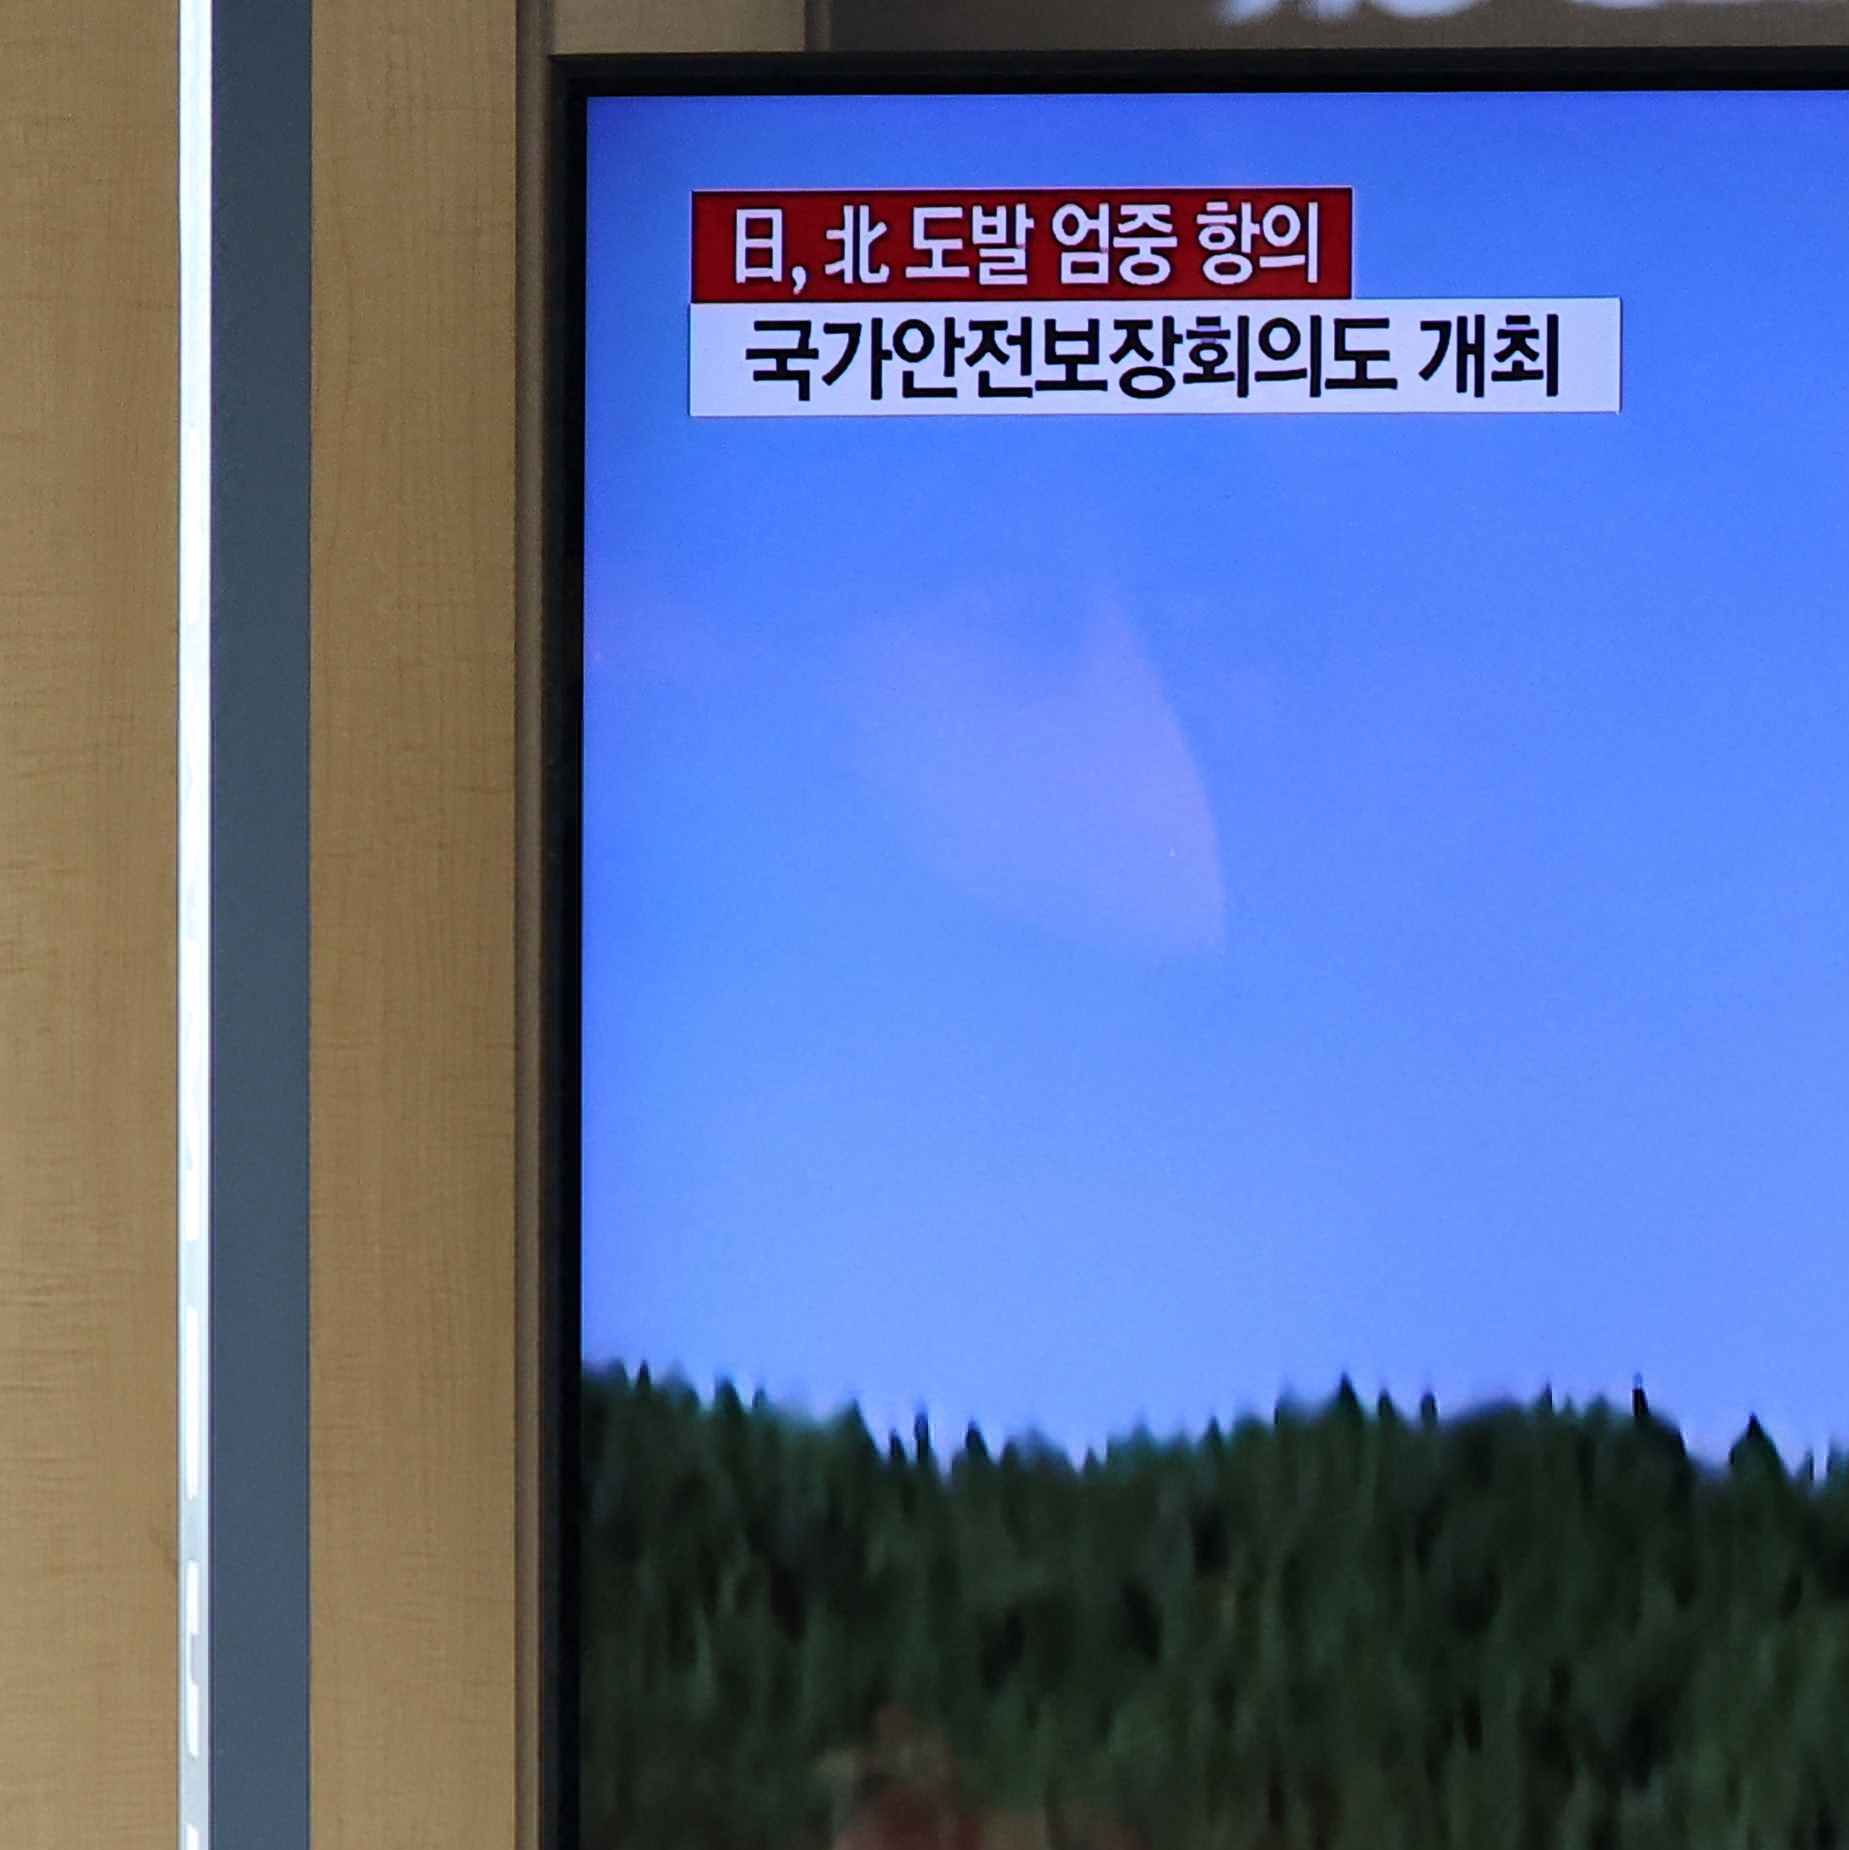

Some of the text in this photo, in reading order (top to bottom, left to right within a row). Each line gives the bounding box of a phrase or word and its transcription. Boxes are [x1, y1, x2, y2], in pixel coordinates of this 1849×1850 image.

[734, 201, 1319, 294] 日, 北 도발 엄중 항의
[744, 312, 1560, 402] 국가안전보장회의도 개최
